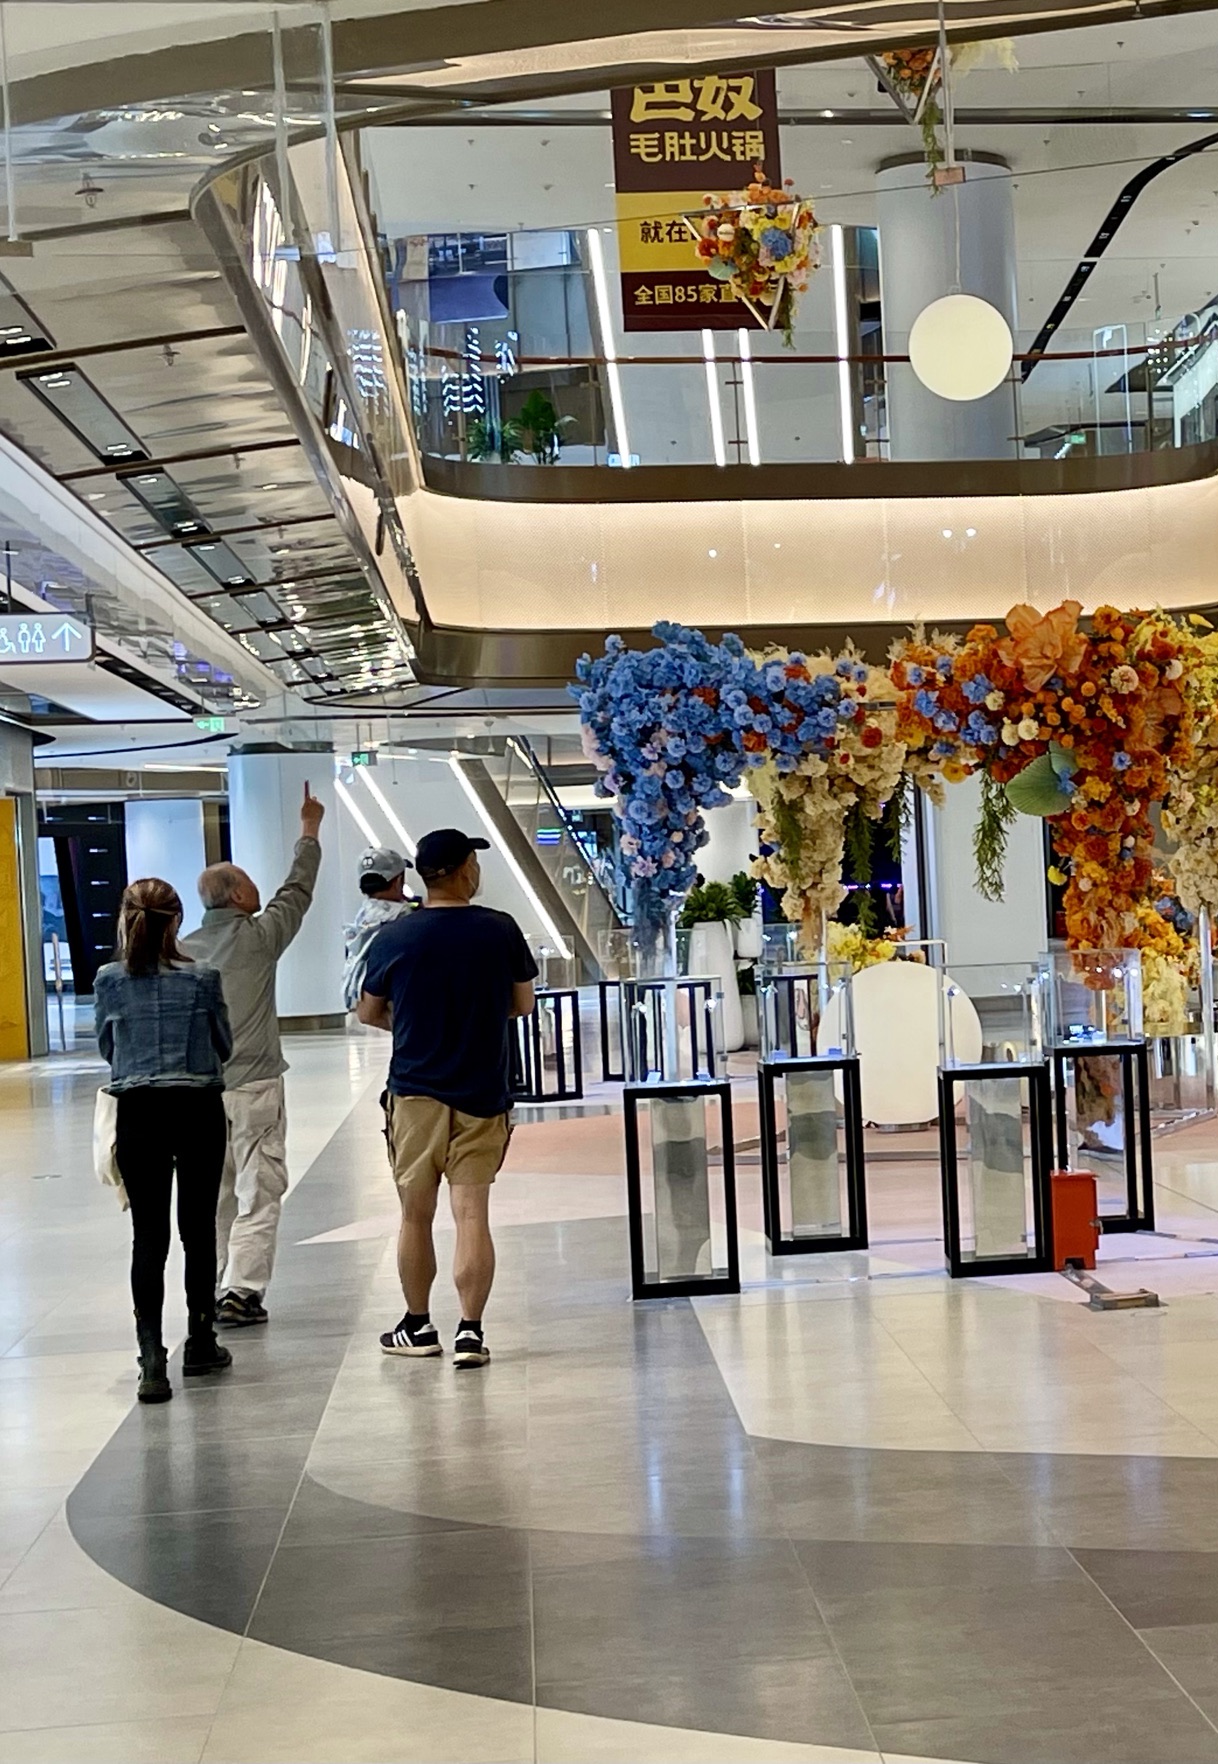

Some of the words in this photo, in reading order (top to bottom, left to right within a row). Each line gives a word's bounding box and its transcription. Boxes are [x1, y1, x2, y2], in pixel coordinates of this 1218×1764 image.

[630, 75, 763, 122] 巴奴
[629, 131, 765, 162] 毛肚火锅
